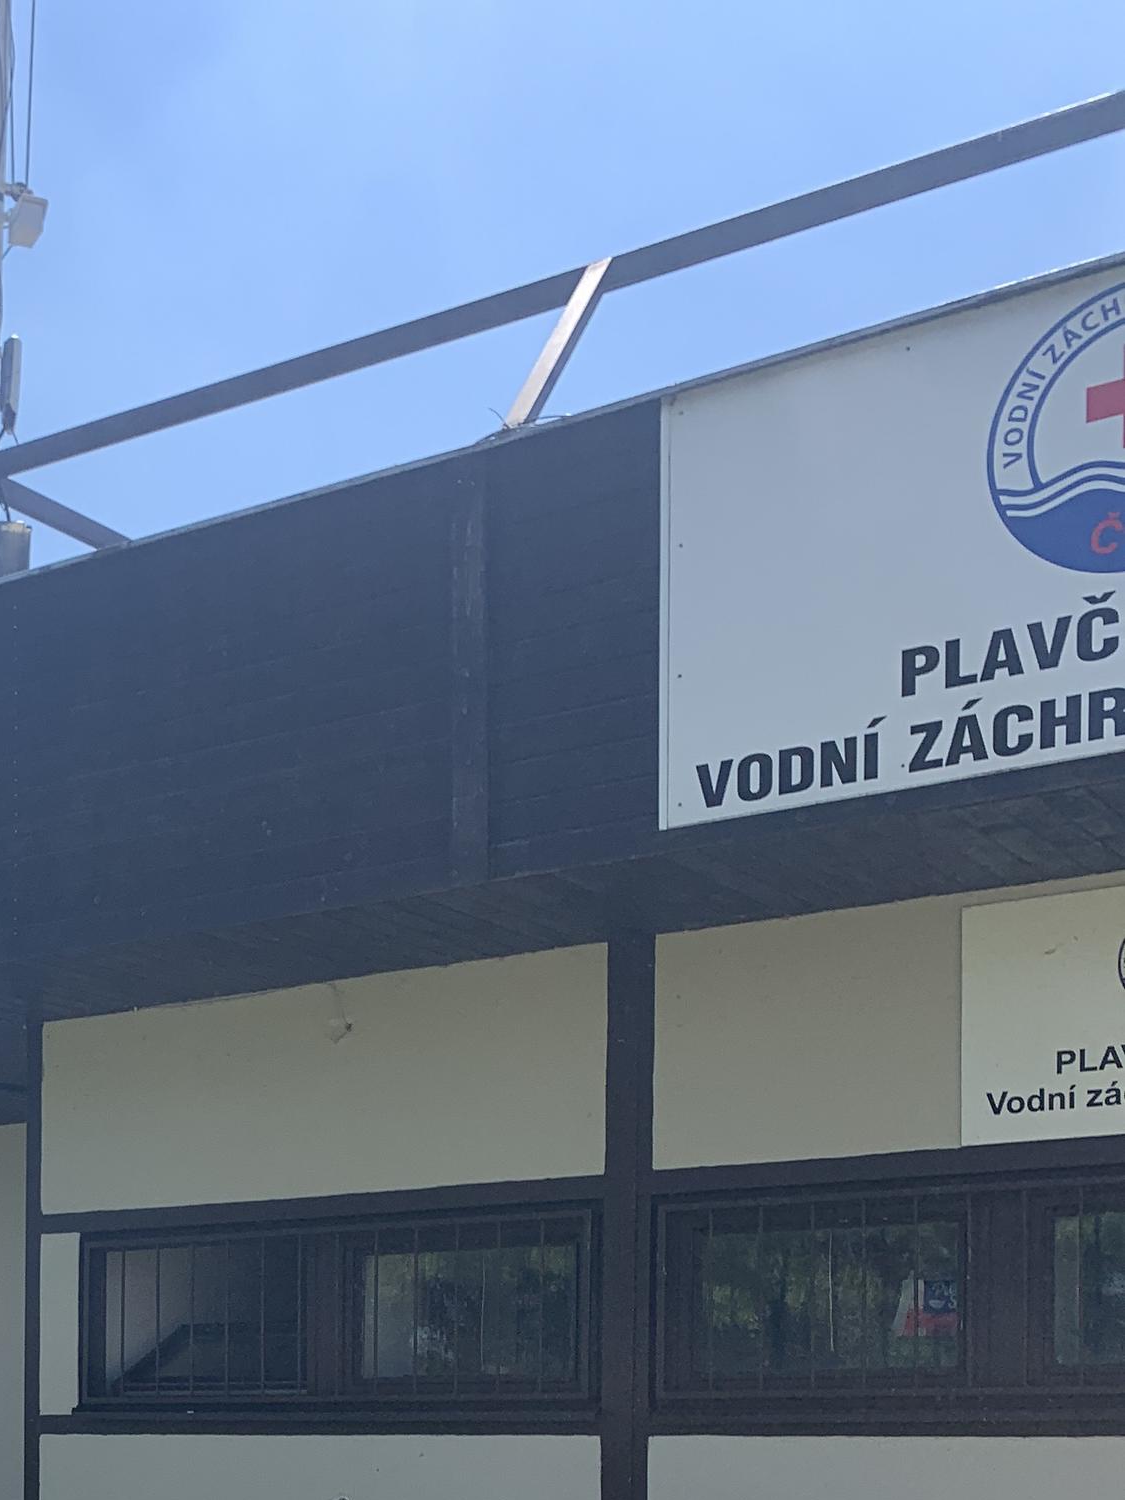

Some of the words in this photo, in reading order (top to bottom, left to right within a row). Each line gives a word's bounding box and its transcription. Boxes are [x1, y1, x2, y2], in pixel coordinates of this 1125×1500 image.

[1002, 367, 1047, 470] VODNÍ
[900, 590, 1120, 697] PLAVČ
[695, 715, 887, 809] VODNÍ
[907, 687, 1125, 773] ZÁCHR
[985, 1083, 1077, 1116] Vodní
[1085, 1080, 1125, 1108] zá
[1056, 1044, 1125, 1075] PLA
